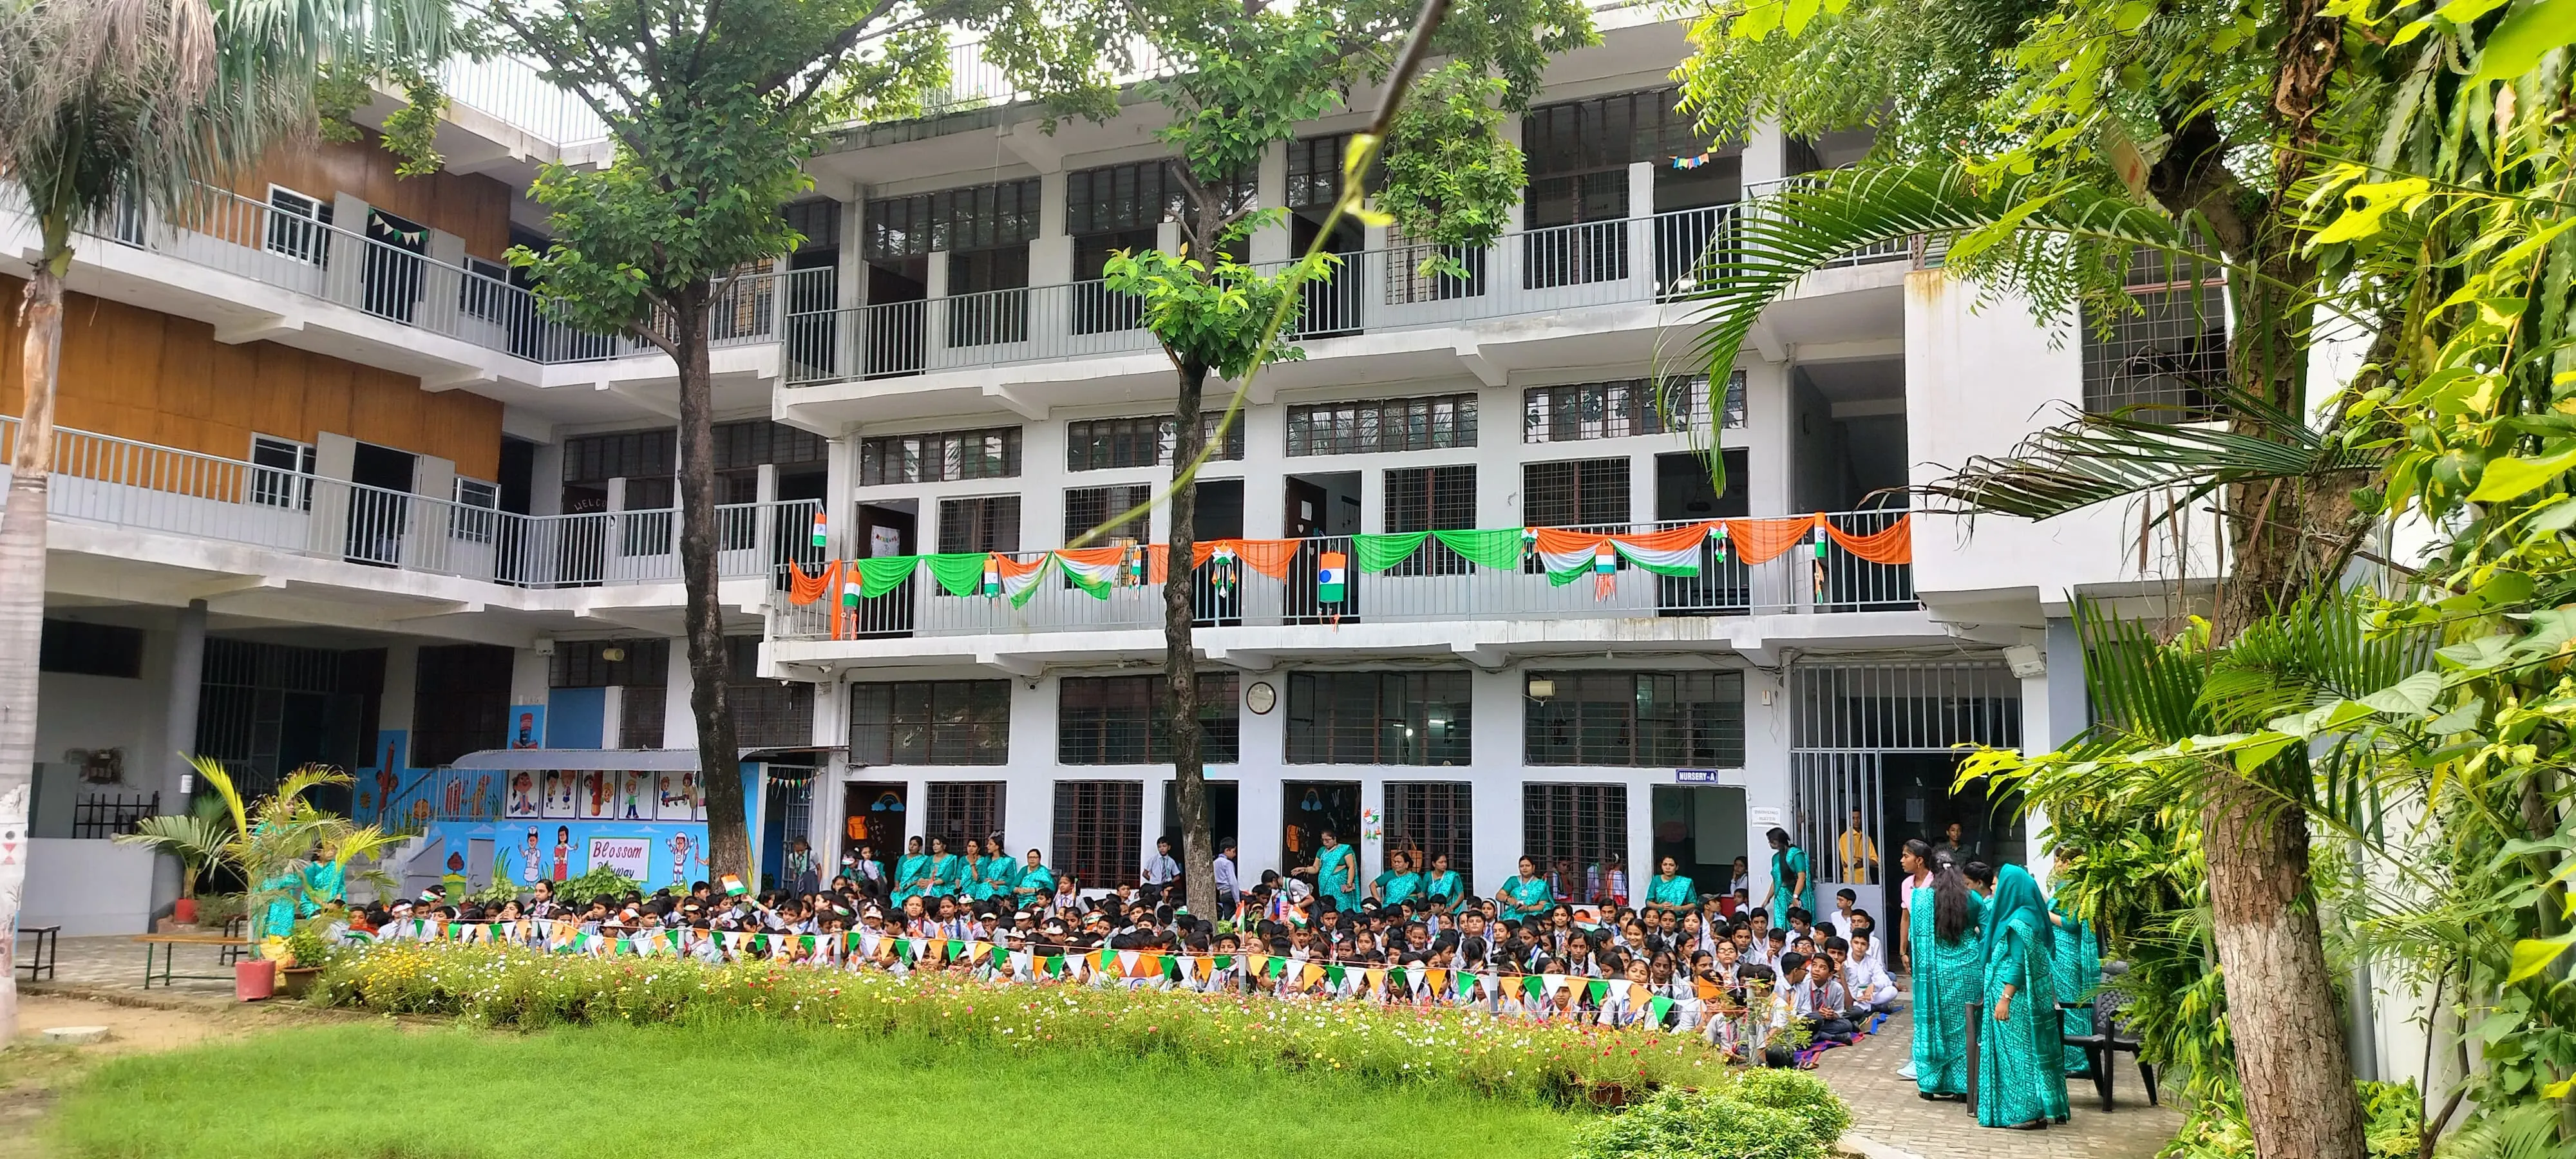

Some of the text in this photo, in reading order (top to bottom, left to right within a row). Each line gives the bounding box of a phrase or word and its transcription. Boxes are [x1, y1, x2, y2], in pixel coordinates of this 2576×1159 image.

[574, 498, 607, 511] WELCO
[1678, 771, 1715, 781] NURSERY-A
[592, 841, 643, 858] Blossom
